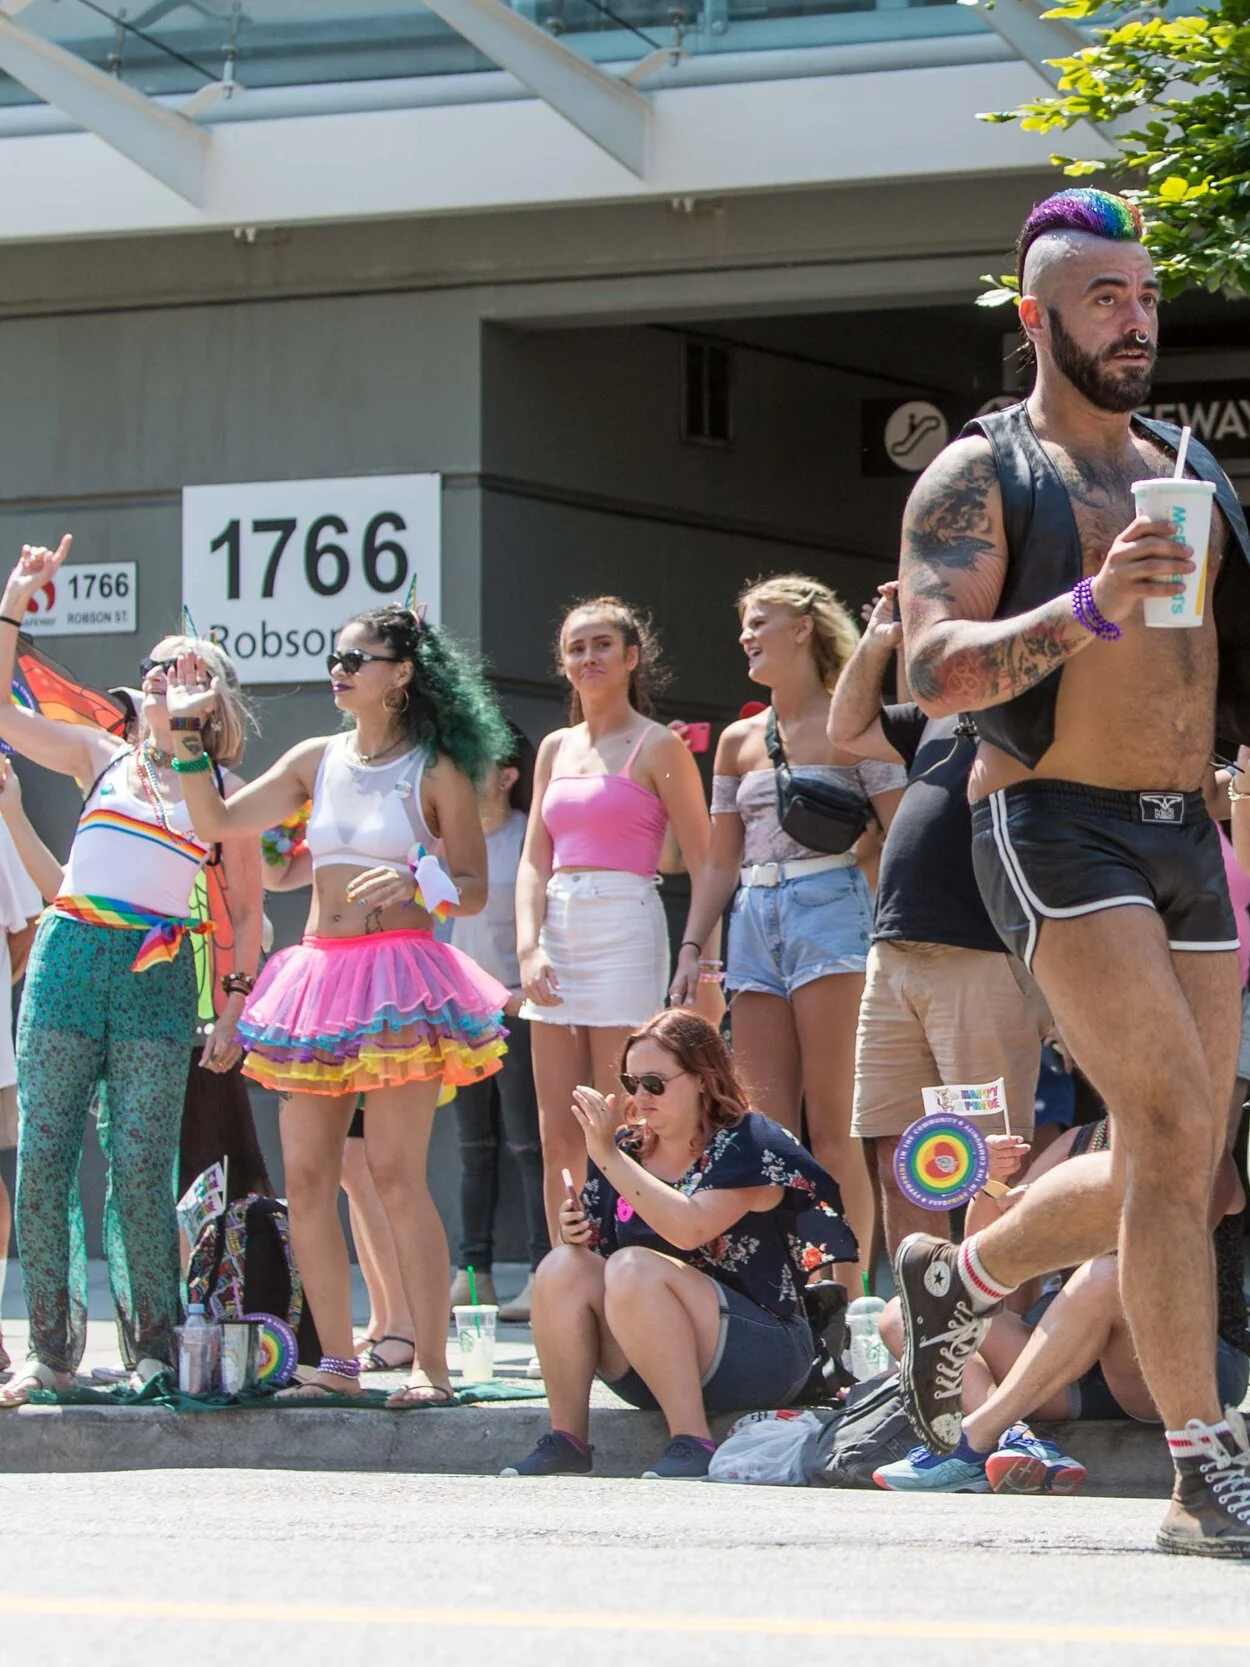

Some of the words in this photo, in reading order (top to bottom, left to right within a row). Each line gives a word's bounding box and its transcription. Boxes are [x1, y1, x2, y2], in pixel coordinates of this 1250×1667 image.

[210, 511, 408, 600] 1766
[68, 573, 129, 599] 1766
[67, 612, 112, 625] ROBSON
